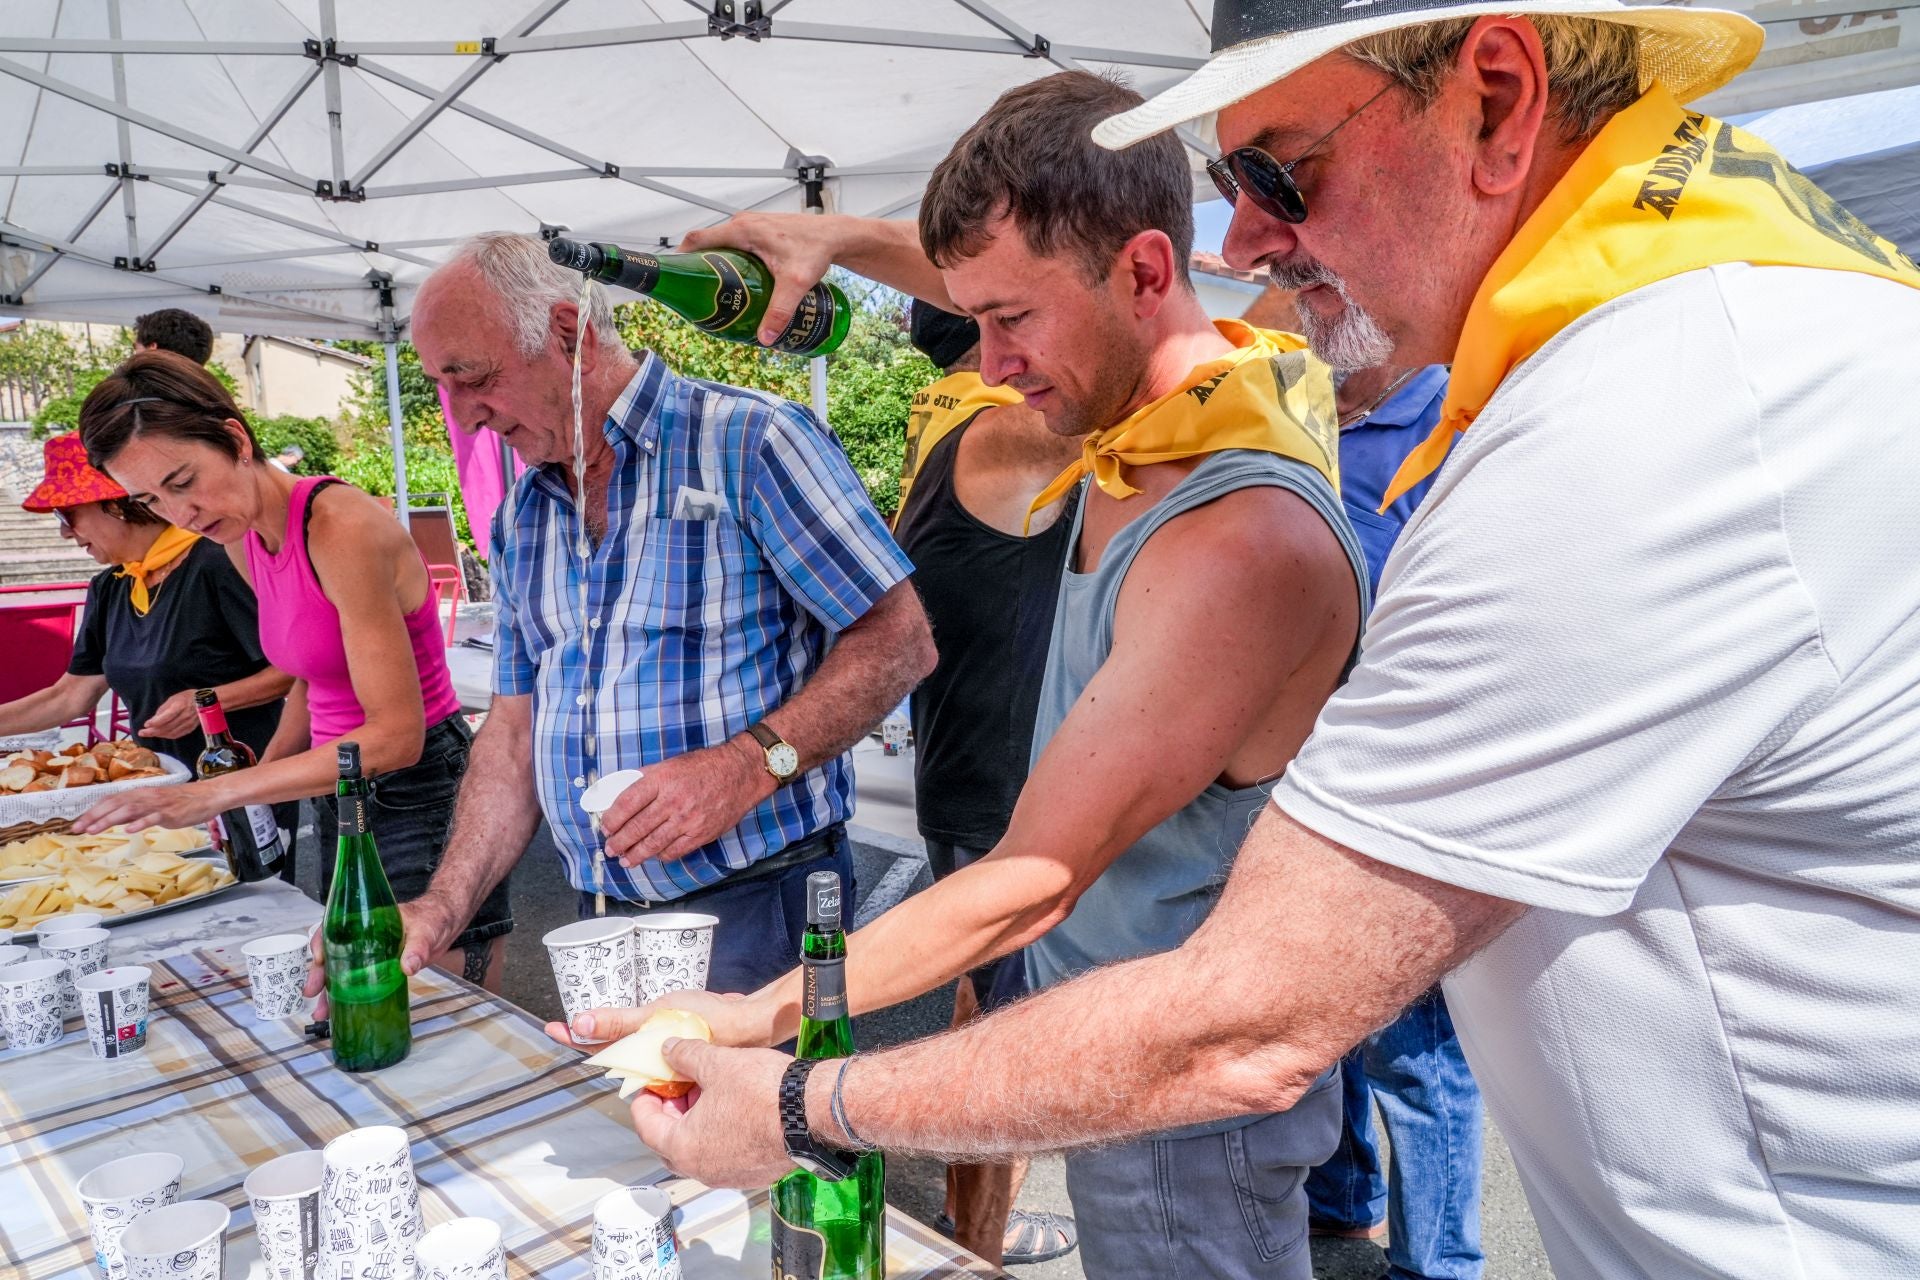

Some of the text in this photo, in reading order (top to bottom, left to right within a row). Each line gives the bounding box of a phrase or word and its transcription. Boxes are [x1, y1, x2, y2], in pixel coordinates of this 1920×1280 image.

[732, 288, 743, 311] 2024
[806, 966, 816, 1016] GORENAK
[331, 1239, 354, 1252] BLACK
[607, 1231, 633, 1244] coffee
